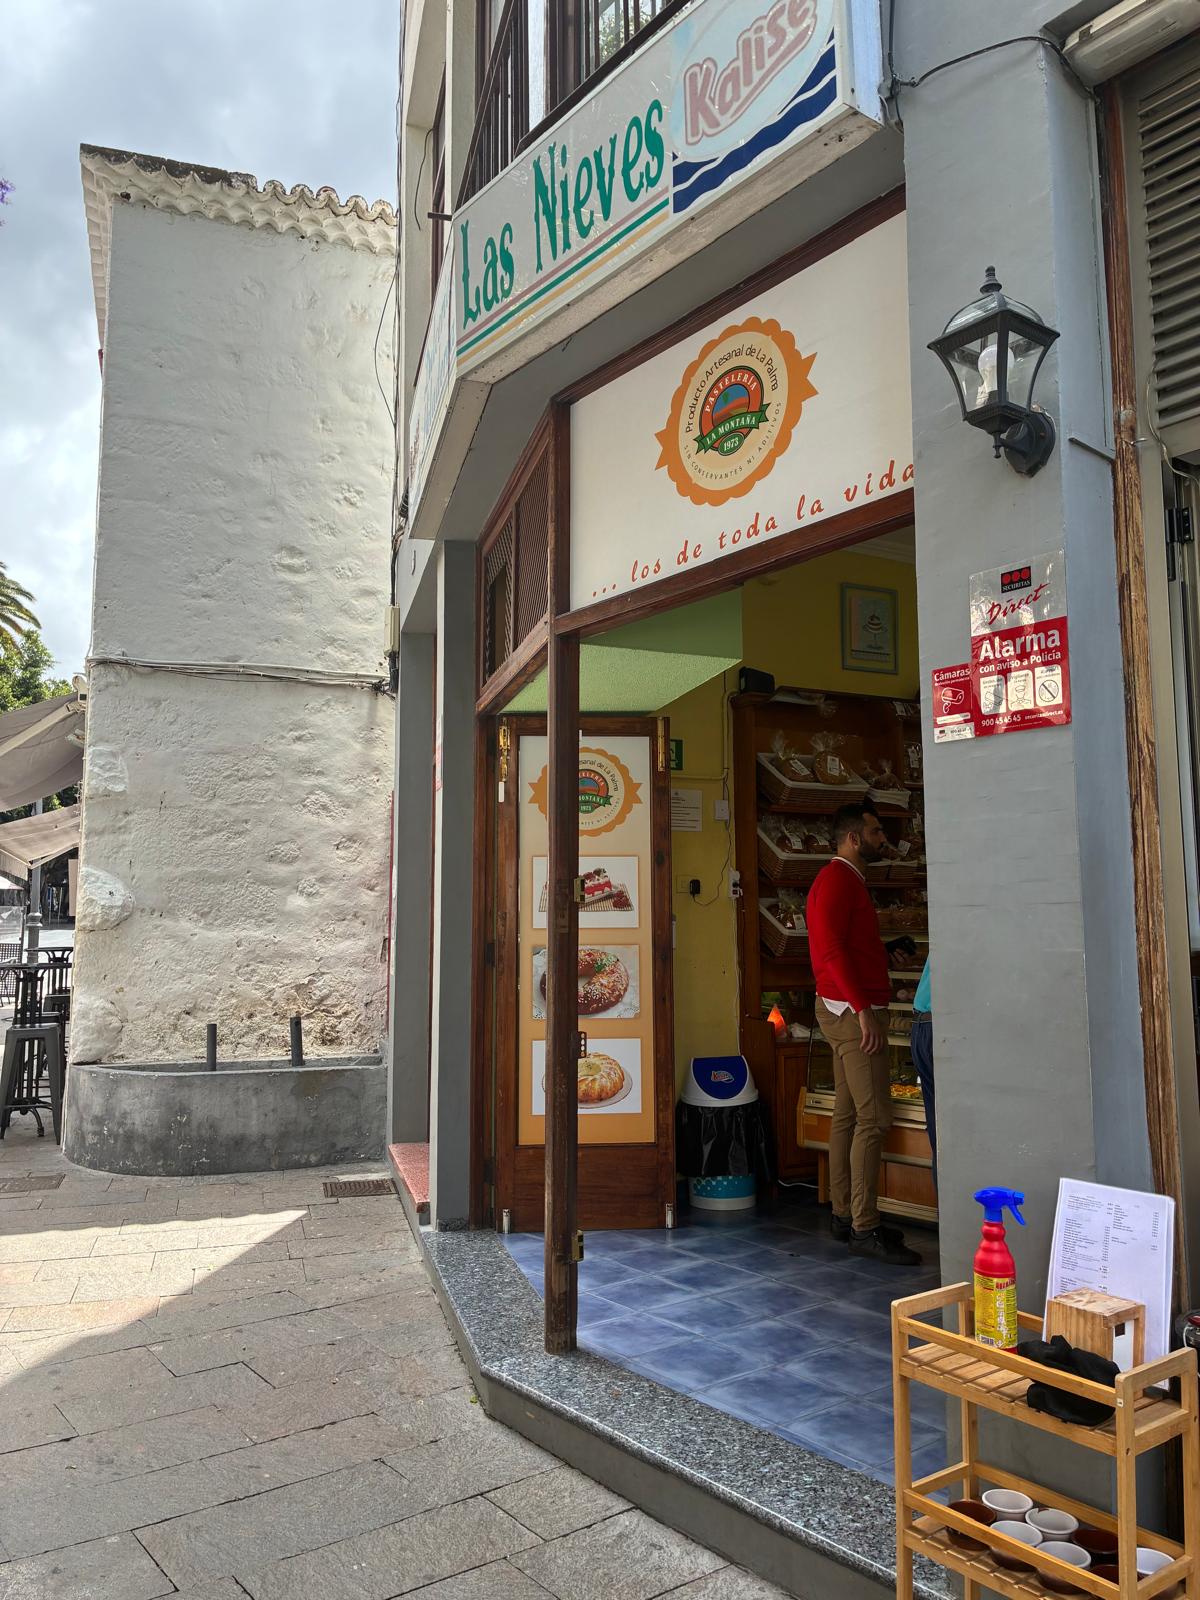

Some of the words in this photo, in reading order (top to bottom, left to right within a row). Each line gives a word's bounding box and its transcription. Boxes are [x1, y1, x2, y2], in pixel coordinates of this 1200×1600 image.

[685, 0, 817, 145] Kalise
[460, 219, 514, 329] Las
[533, 99, 665, 274] Nieves
[685, 380, 706, 433] Producto
[704, 344, 745, 381] Artesanal
[745, 344, 756, 356] de
[755, 348, 766, 363] La
[764, 358, 779, 392] Palma
[704, 371, 758, 413] PASTELERÍA
[684, 445, 692, 460] SIN
[691, 461, 743, 481] CONSERVANTES
[758, 402, 782, 452] ADITIVOS
[706, 433, 716, 445] LA
[717, 412, 756, 433] MONTAÑA
[723, 437, 739, 452] 1973
[631, 559, 661, 583] los
[676, 539, 703, 566] de
[718, 511, 779, 551] toda
[796, 494, 824, 520] la
[843, 459, 914, 502] vida
[987, 582, 1051, 626] Direct
[1002, 580, 1031, 591] SECURITAS
[979, 629, 1061, 662] Alarma
[979, 664, 995, 674] con
[996, 658, 1020, 670] aviso
[1030, 650, 1061, 664] Policía
[934, 668, 971, 682] Cámaras
[981, 719, 994, 727] 900
[995, 717, 1003, 725] 45
[1004, 715, 1012, 723] 45
[1013, 714, 1021, 722] 45
